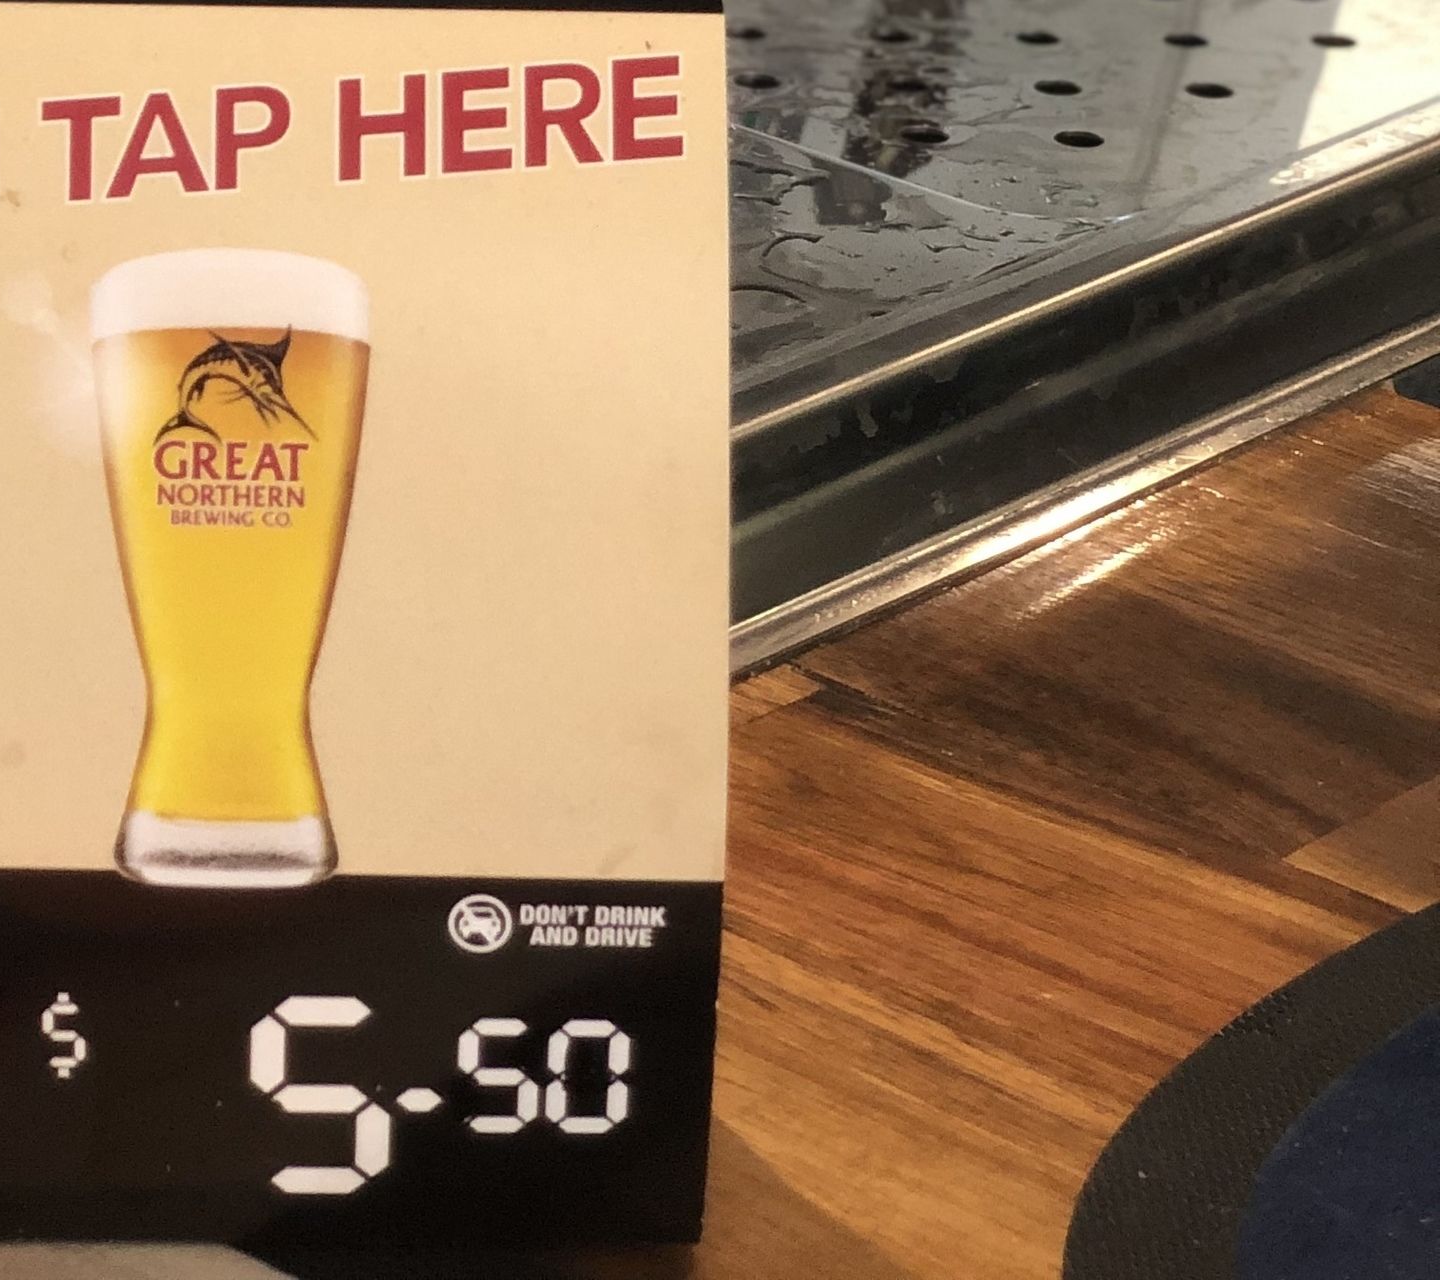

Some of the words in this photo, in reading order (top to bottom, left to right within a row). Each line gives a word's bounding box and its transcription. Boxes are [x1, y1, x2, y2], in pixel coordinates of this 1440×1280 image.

[43, 87, 291, 201] TAP
[340, 57, 684, 181] HERE
[153, 440, 310, 482] GREAT
[157, 483, 306, 508] NORTHERN
[170, 509, 255, 528] BREWING
[519, 903, 590, 926] DON'T
[594, 906, 668, 928] DRINK
[529, 925, 578, 947] AND
[585, 926, 654, 948] DRIVE
